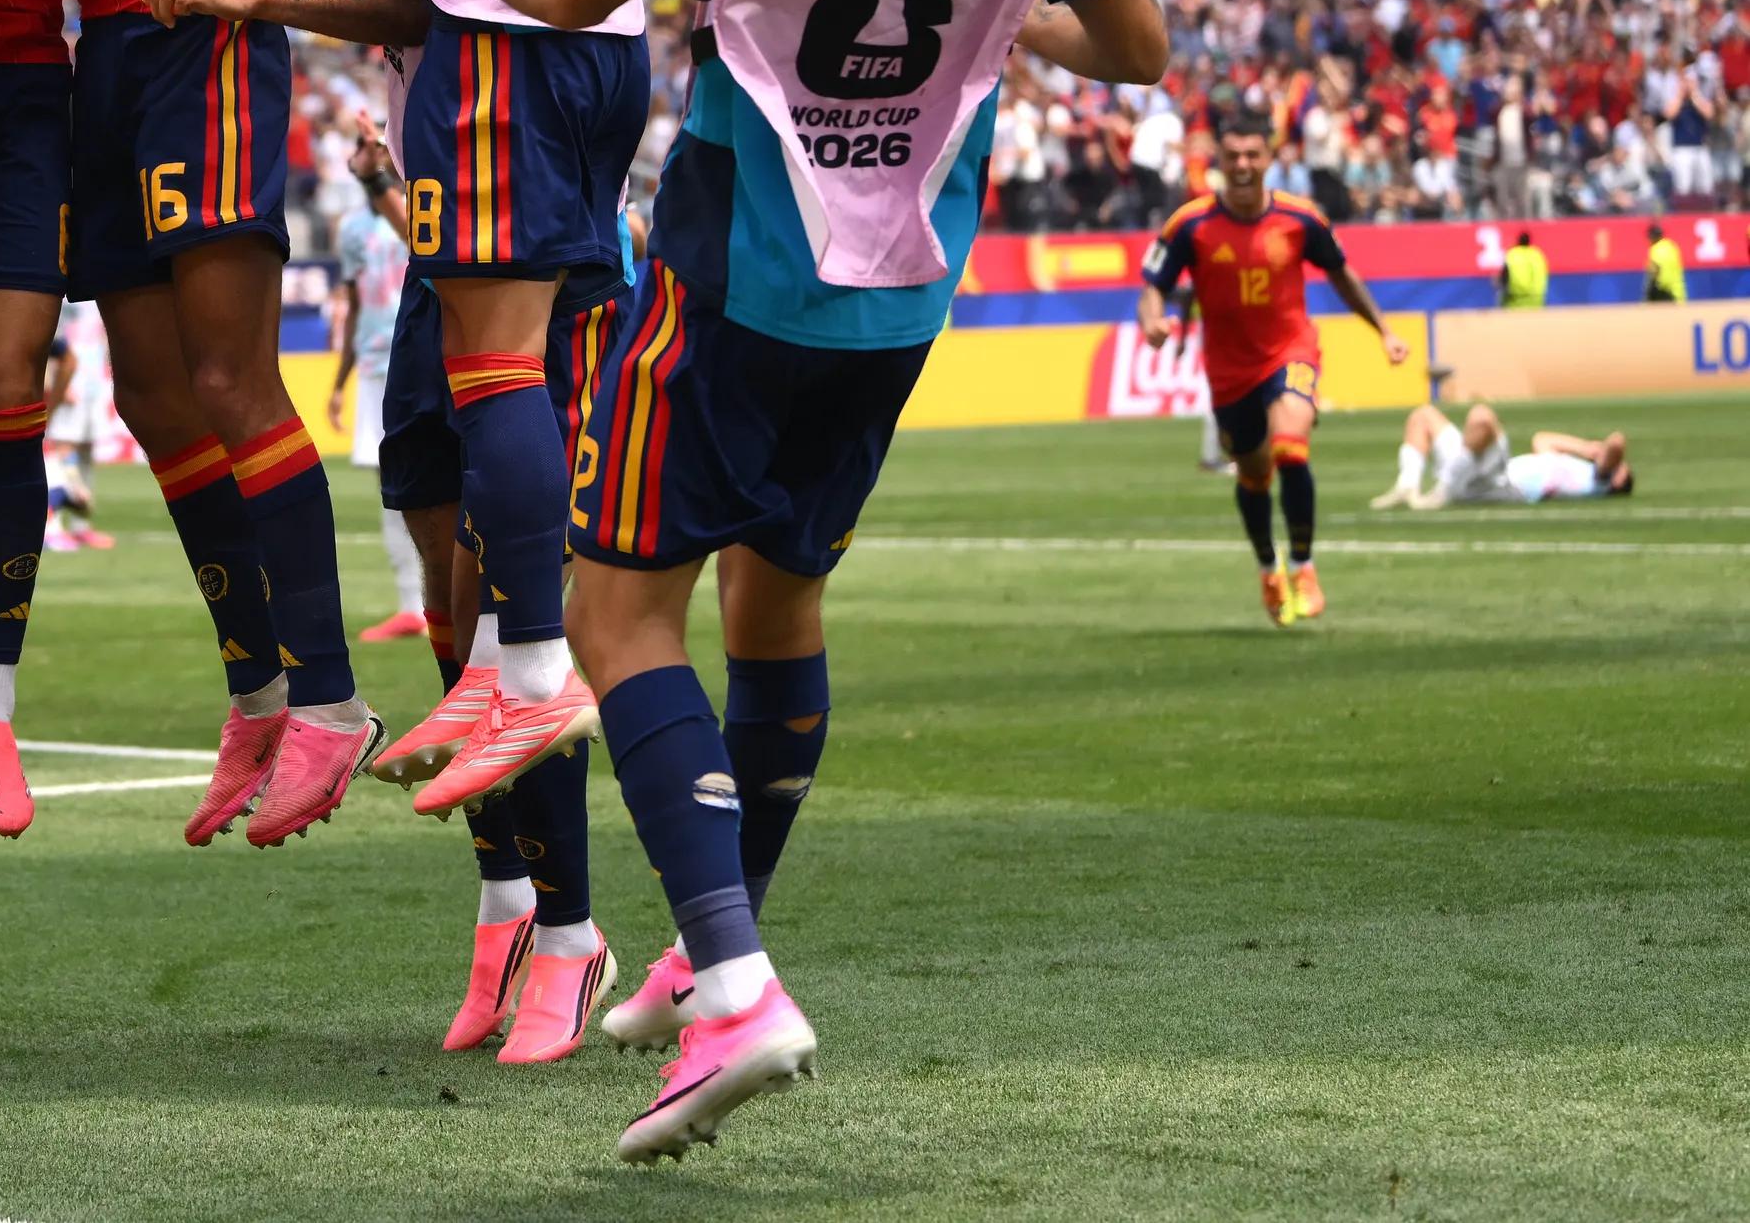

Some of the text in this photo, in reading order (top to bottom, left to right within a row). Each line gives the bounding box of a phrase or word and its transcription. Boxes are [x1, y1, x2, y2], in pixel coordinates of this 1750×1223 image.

[840, 55, 902, 79] FIFA
[788, 106, 920, 128] WORLD CUP
[797, 132, 912, 168] 2026
[140, 162, 188, 240] 16
[1238, 267, 1270, 305] 12
